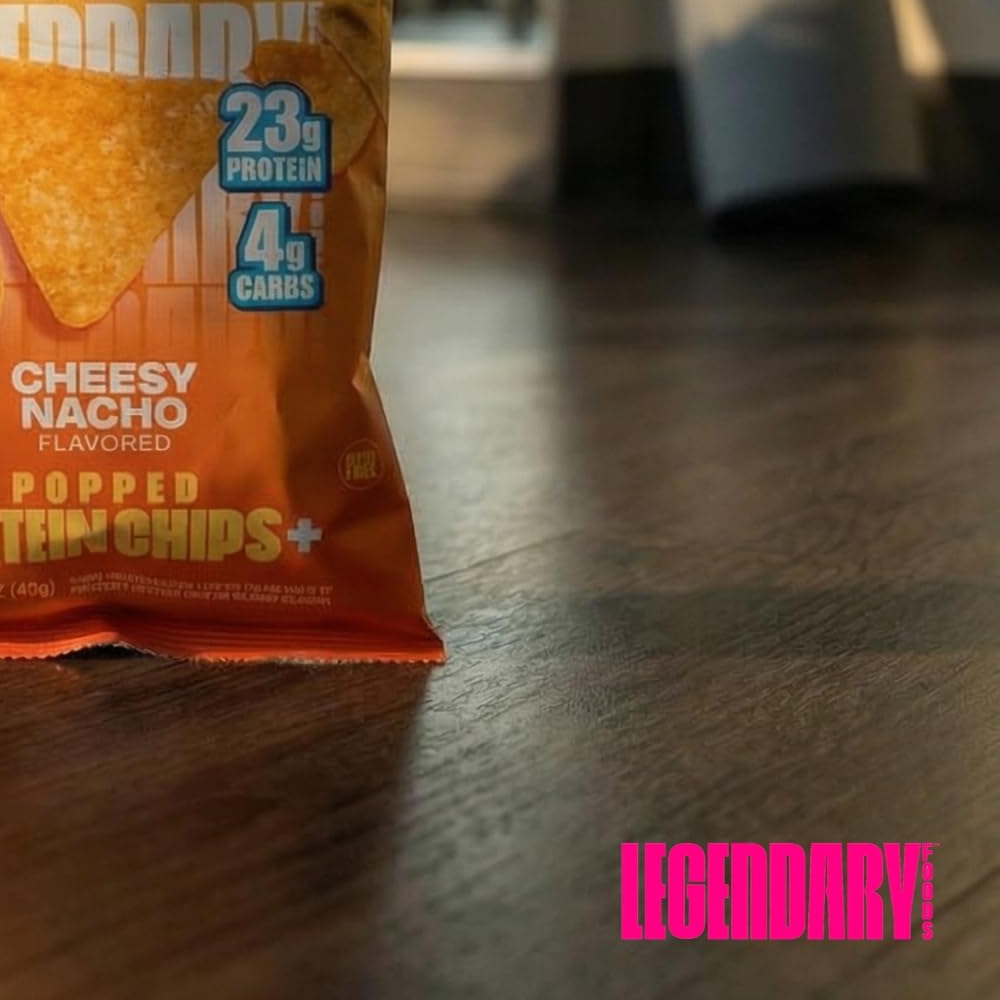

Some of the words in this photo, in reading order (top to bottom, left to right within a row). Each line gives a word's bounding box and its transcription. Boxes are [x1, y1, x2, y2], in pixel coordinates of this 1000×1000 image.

[226, 89, 322, 153] 23g
[244, 209, 305, 272] 4g
[236, 274, 315, 301] CARBS
[11, 361, 197, 394] CHEESY
[21, 397, 188, 429] NACHO
[38, 434, 172, 452] FLAVORED
[12, 471, 199, 504] POPPED
[10, 580, 56, 599] (40g)
